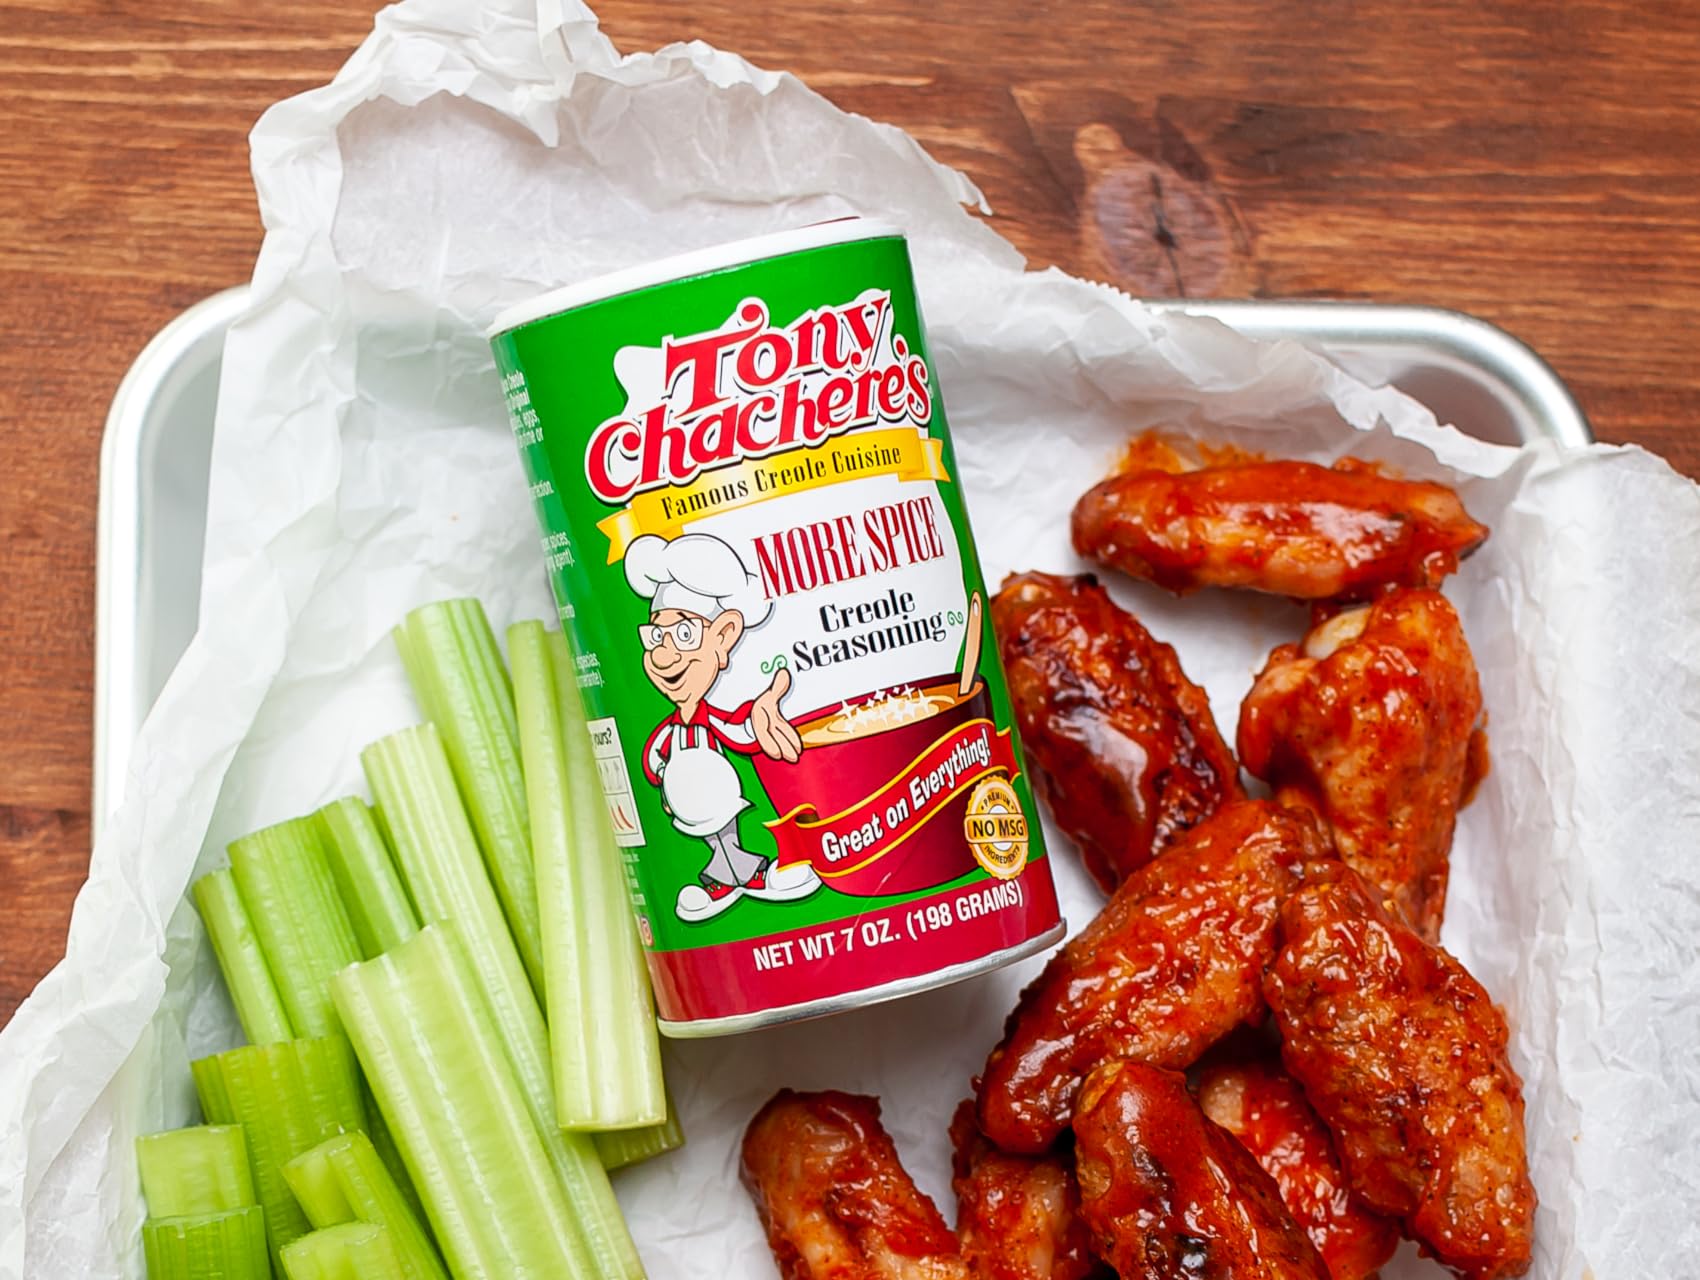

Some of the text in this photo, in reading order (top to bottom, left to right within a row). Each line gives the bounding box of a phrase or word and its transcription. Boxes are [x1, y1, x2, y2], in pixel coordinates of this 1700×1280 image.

[665, 297, 889, 418] Tony
[588, 339, 929, 497] Chachere's
[662, 446, 902, 520] Famous Creole Cuisine
[751, 496, 944, 601] MORE SPICE
[792, 611, 947, 672] Seasoning
[819, 589, 916, 633] Creole
[821, 728, 992, 862] Great on Everything!
[972, 819, 1024, 837] NO MSG
[983, 791, 1011, 807] PREMIUM
[752, 880, 1023, 971] NET WT 7 OZ. (198 GRAMS)
